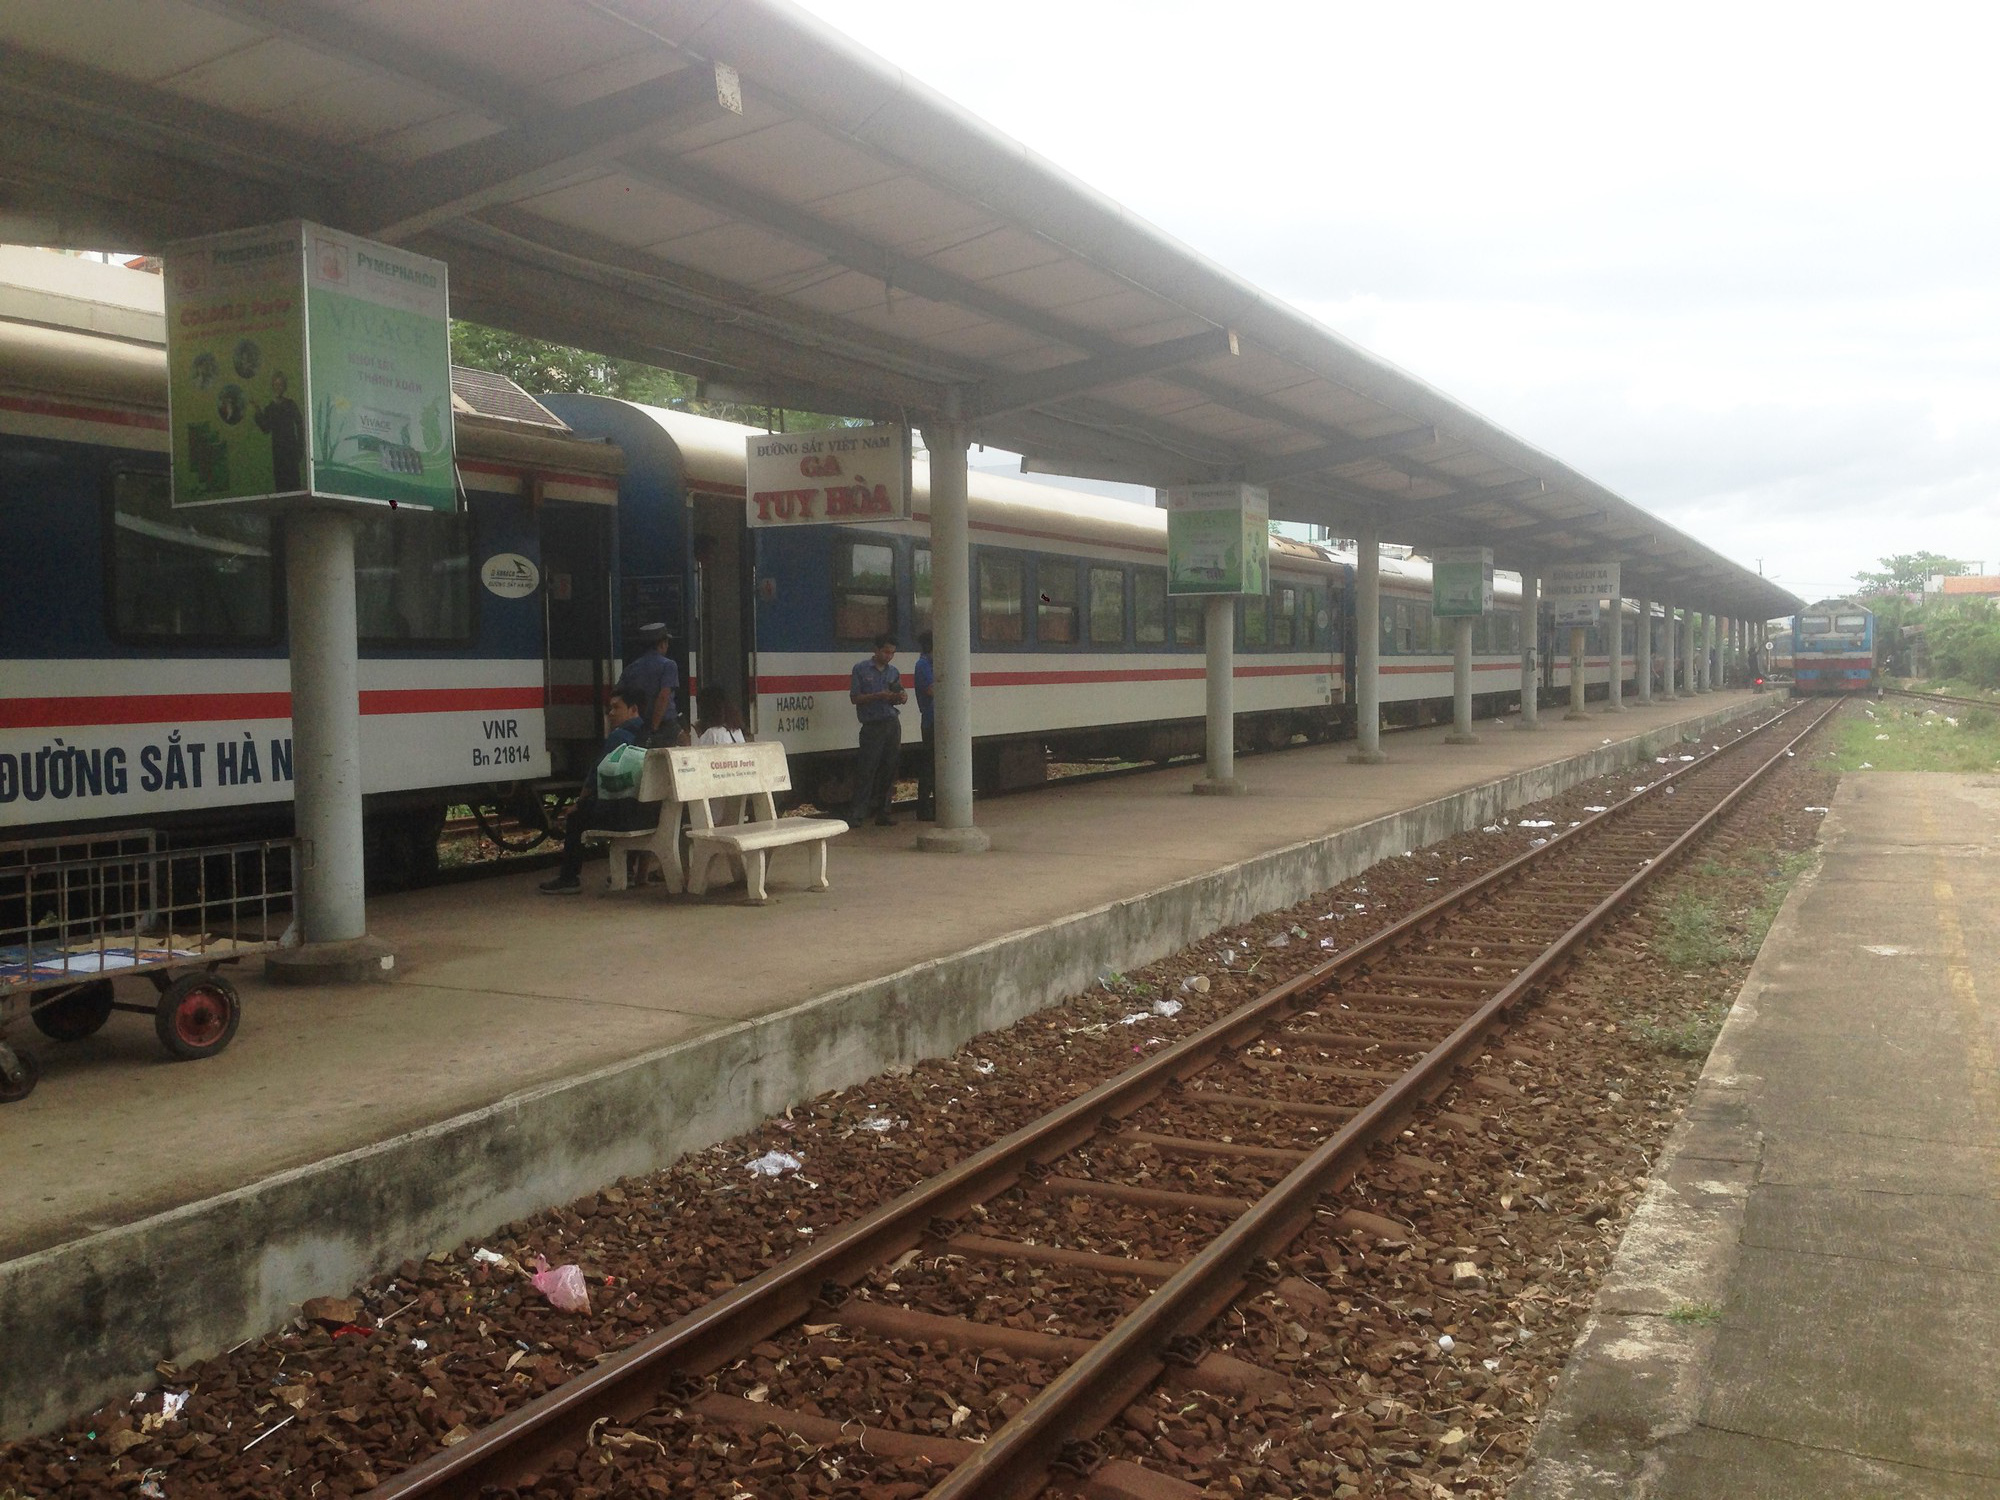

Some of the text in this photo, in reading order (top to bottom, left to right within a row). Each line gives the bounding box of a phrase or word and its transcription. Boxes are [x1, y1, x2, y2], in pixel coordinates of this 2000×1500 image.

[356, 252, 437, 288] PYMEPHARCO
[757, 441, 798, 457] ĐƯỜNG
[862, 436, 890, 448] NAM
[800, 454, 842, 478] GA
[752, 474, 894, 520] TUY HÒA
[776, 695, 814, 711] HARACO
[482, 719, 519, 740] VNR
[777, 716, 809, 732] A 31491
[472, 745, 531, 766] Bn 21814
[710, 759, 738, 771] COLDFLU
[0, 738, 128, 804] ĐƯỜNG
[140, 729, 206, 792] SẮT
[216, 731, 262, 786] HÀ
